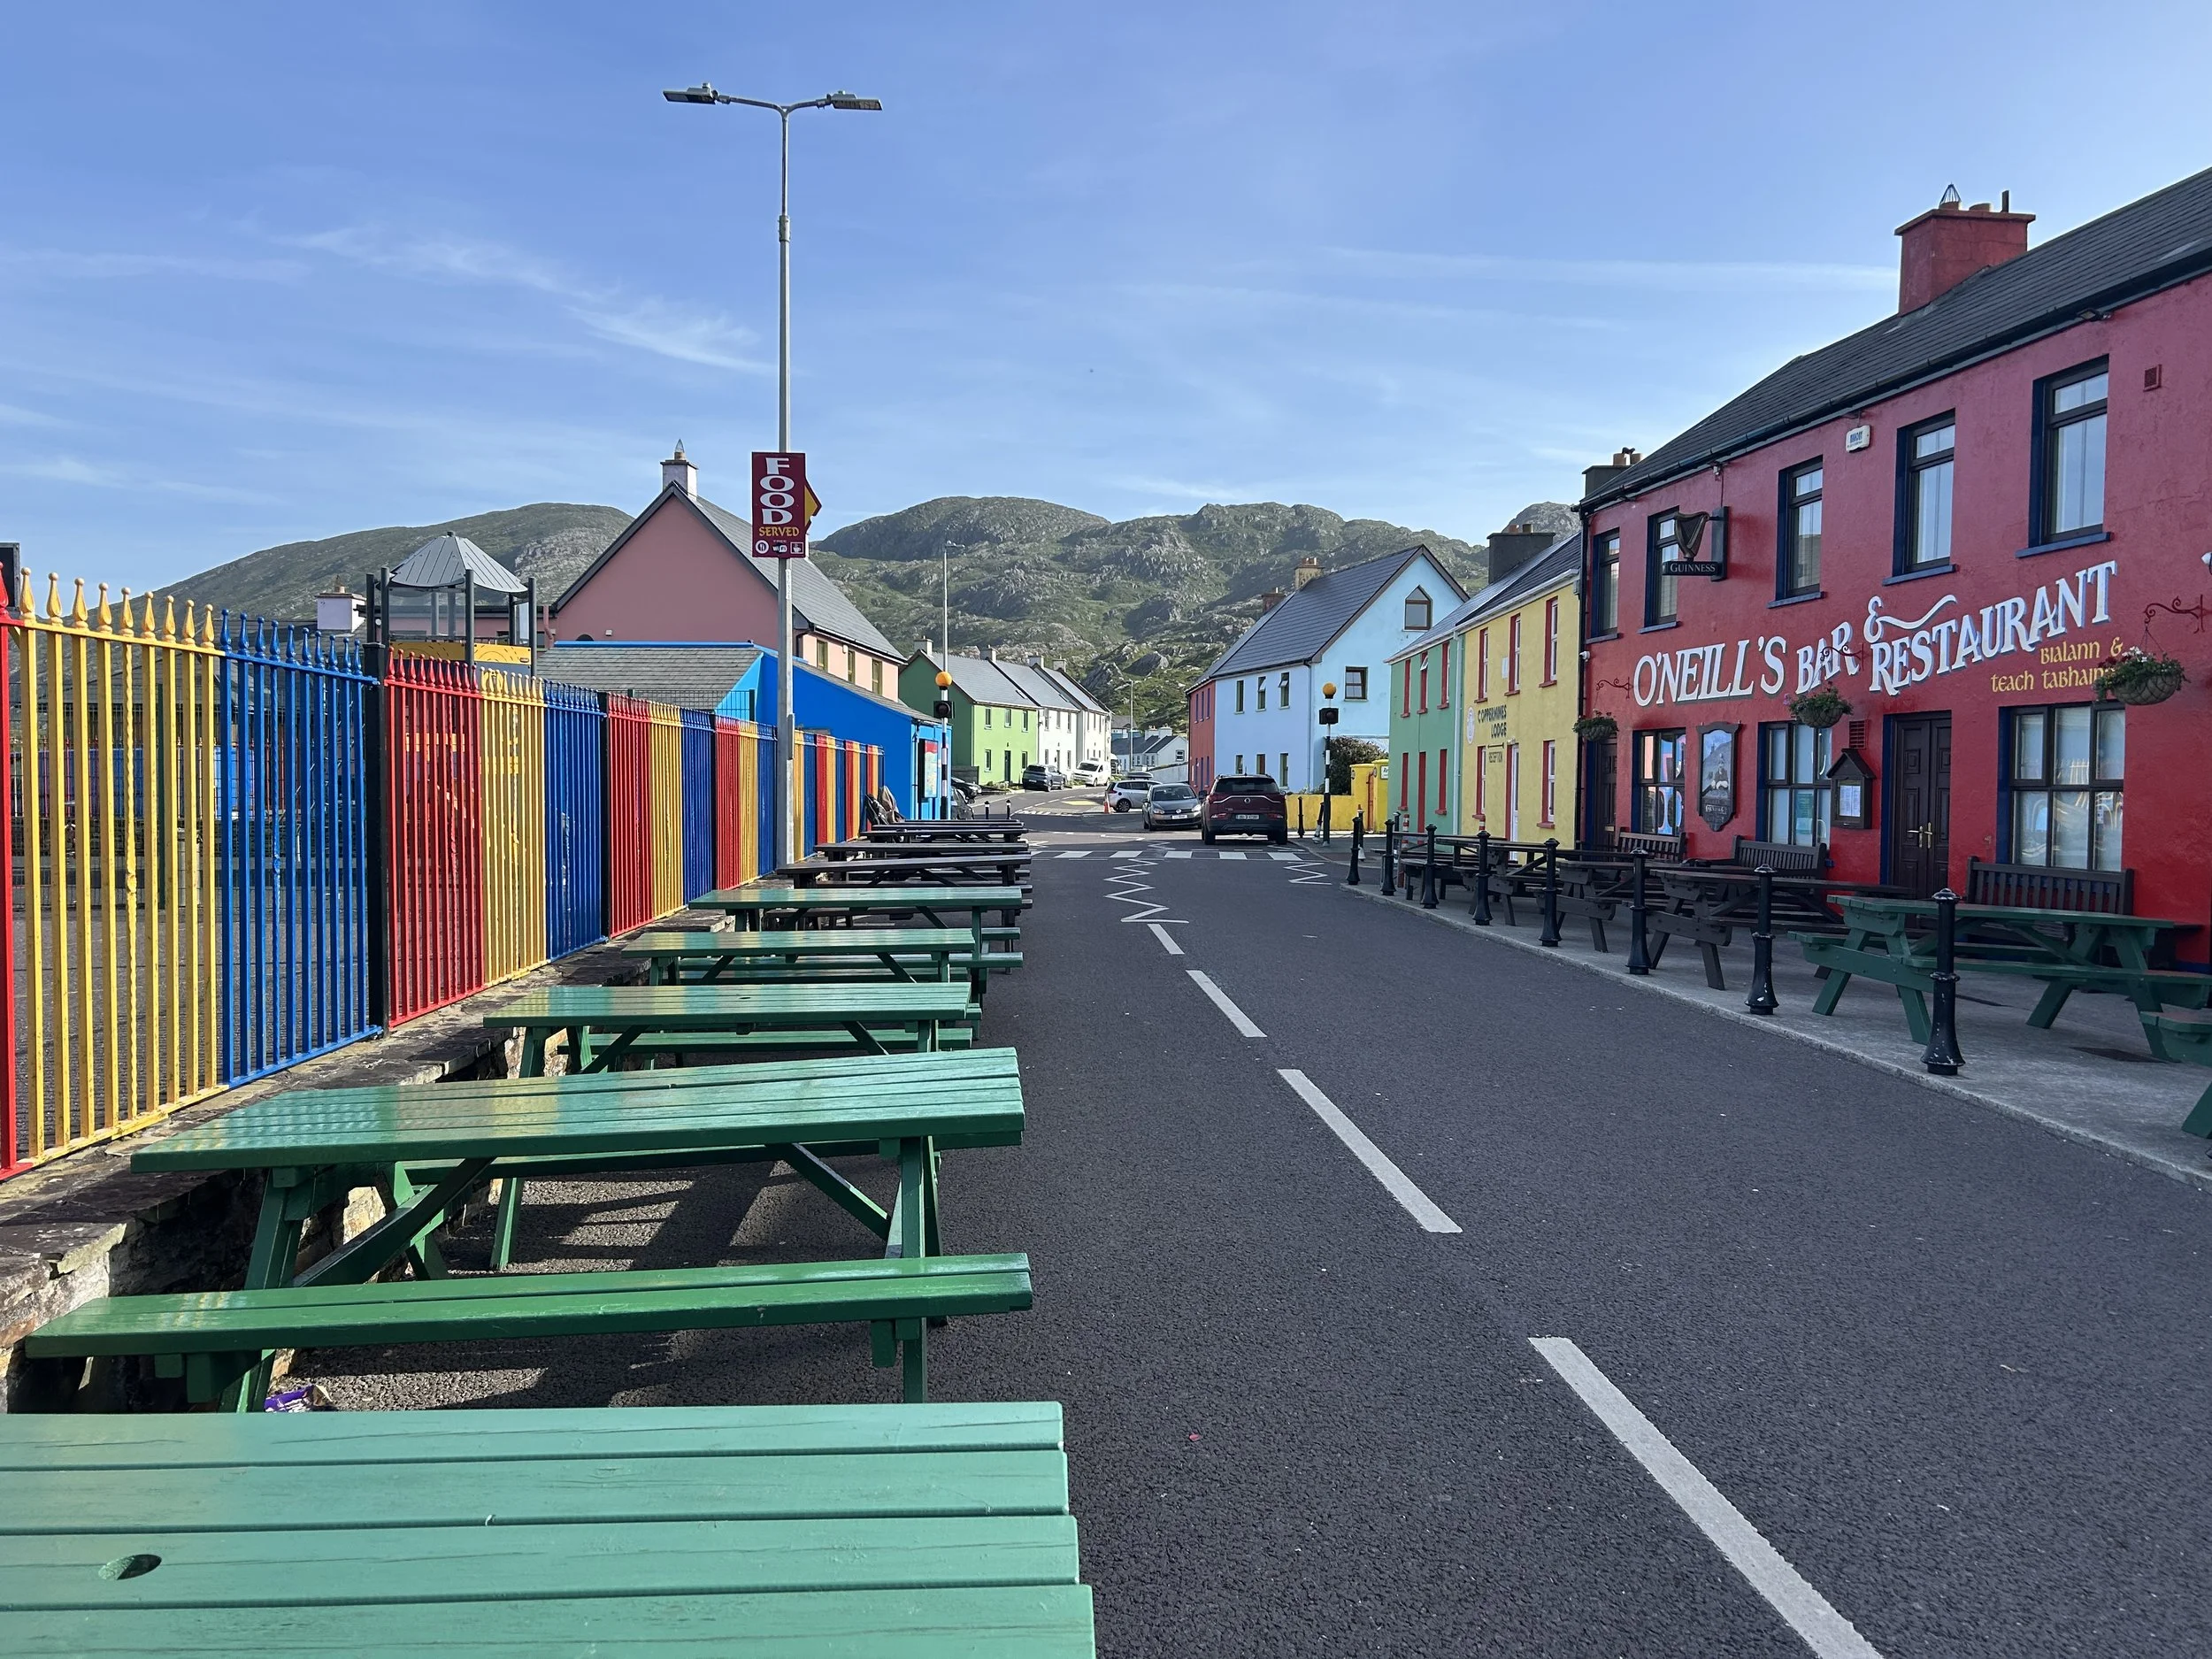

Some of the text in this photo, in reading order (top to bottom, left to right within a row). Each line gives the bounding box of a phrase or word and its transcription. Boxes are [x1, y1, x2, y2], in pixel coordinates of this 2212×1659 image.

[760, 457, 795, 525] FOOD
[759, 526, 800, 536] SERVED
[1670, 563, 1716, 572] GUINNESS
[1633, 635, 1787, 707] O'NEILL'S
[1794, 621, 1860, 695] BAR
[1869, 560, 2117, 695] RESTAURANT
[2110, 636, 2124, 657] &
[1491, 722, 1507, 739] LODGE
